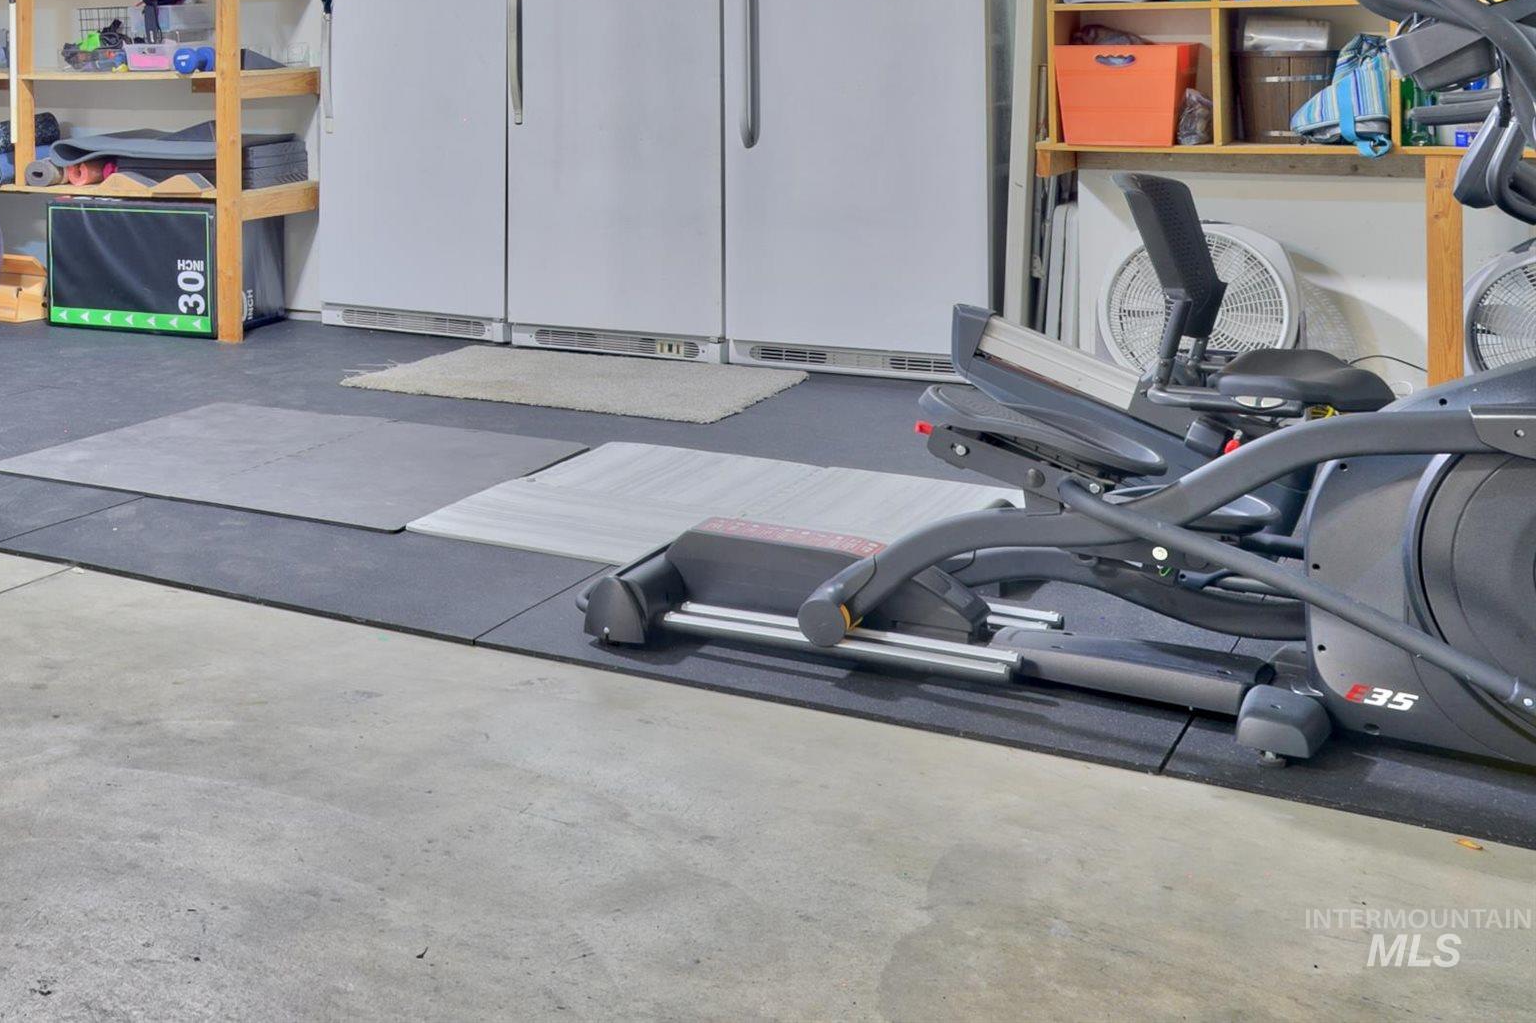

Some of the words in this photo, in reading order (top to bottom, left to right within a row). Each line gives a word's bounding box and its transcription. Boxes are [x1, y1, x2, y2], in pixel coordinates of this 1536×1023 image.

[177, 259, 204, 272] INCH
[177, 271, 206, 315] 30
[246, 289, 255, 320] INCH
[1345, 683, 1420, 712] E35
